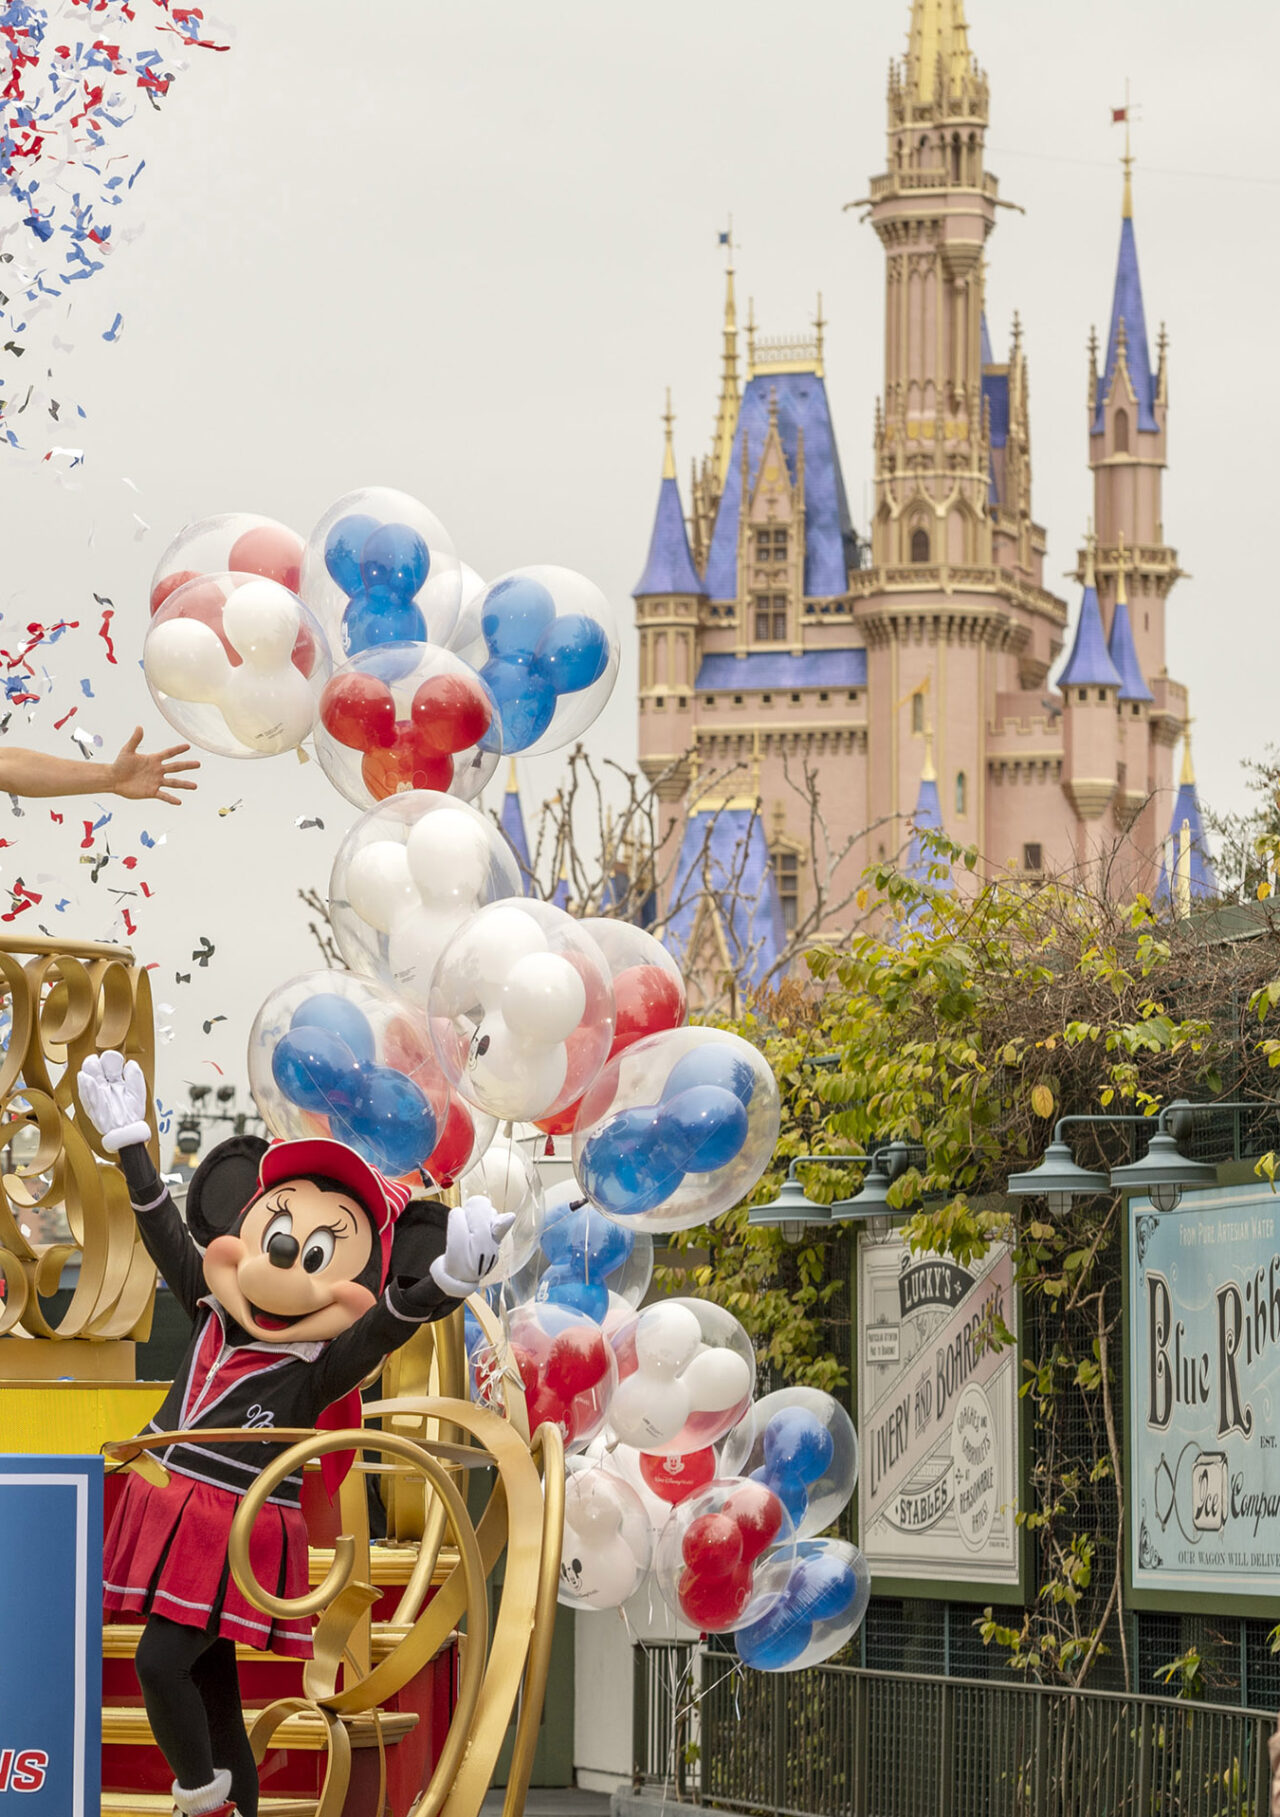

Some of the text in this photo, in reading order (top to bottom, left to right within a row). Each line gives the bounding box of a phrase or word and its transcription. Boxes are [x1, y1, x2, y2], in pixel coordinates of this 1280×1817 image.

[904, 1266, 951, 1308] LUCKY'S
[1145, 1269, 1210, 1431] Blue
[870, 1394, 910, 1498] LIVERY
[915, 1378, 933, 1432] AND
[1260, 1435, 1278, 1449] EST.
[900, 1479, 948, 1525] STABLES
[1195, 1469, 1280, 1538] Ice Compa
[1178, 1551, 1195, 1565] OUR
[1197, 1551, 1226, 1566] WAGON
[1227, 1552, 1250, 1567] WILL
